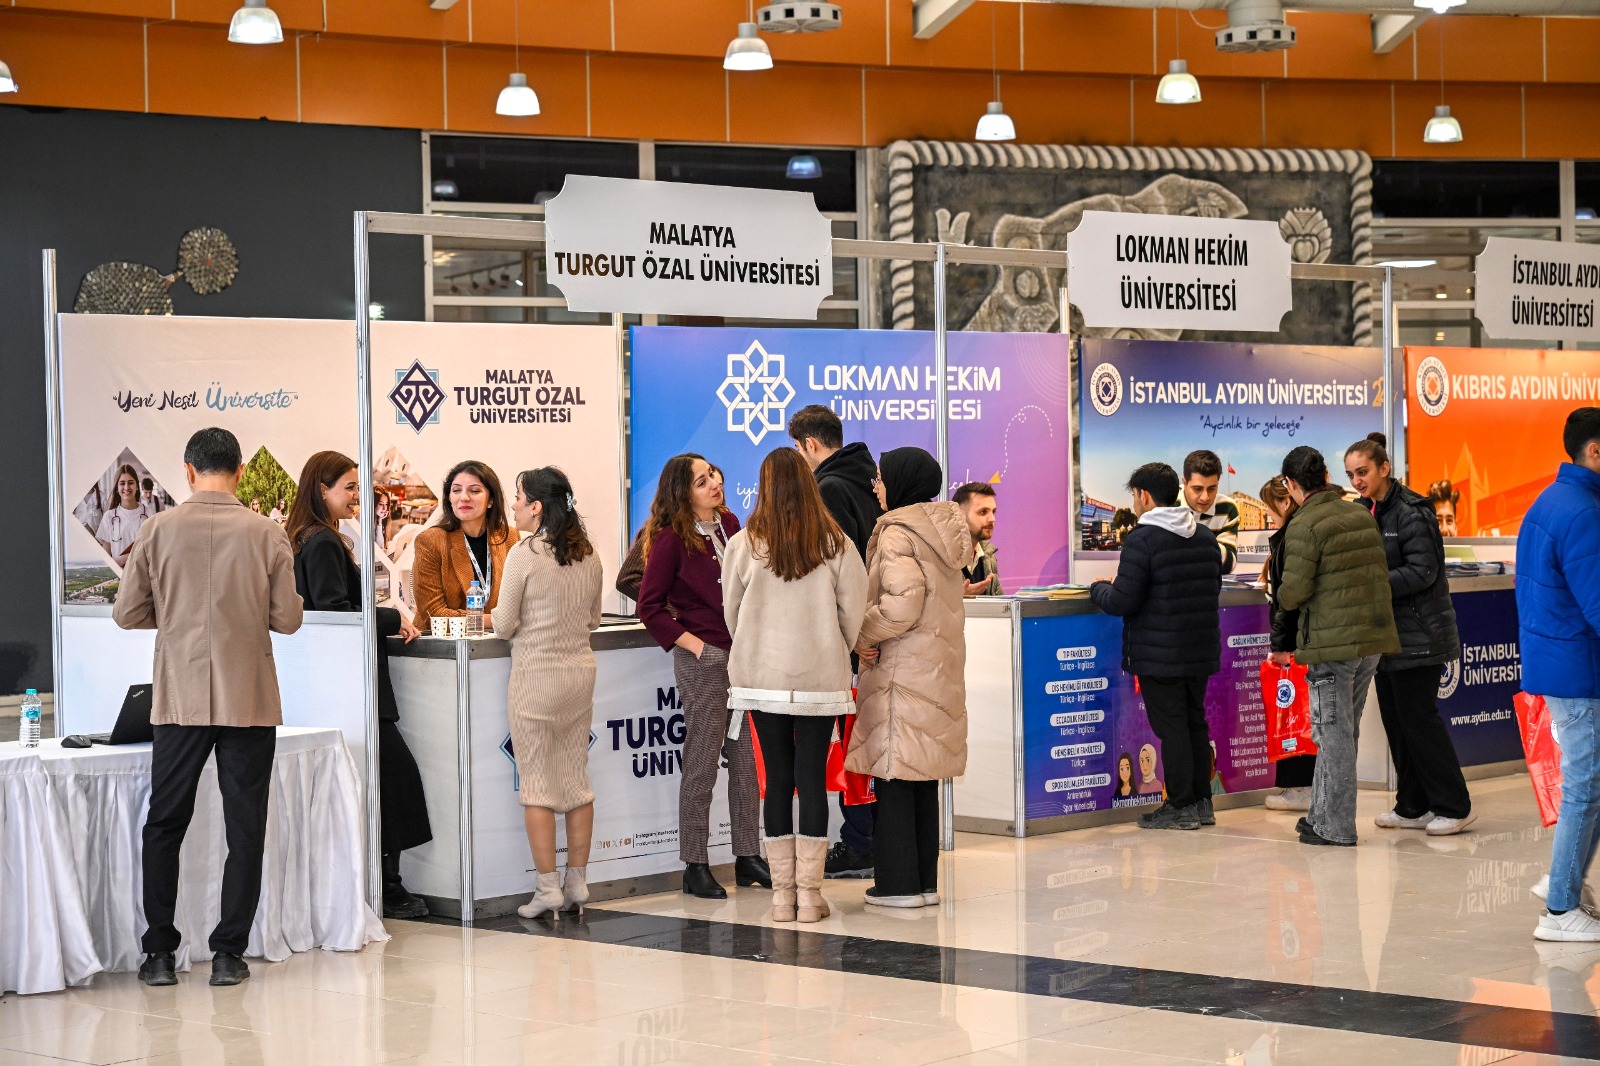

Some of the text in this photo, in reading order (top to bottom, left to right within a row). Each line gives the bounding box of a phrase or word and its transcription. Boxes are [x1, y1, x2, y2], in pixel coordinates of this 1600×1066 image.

[650, 221, 736, 248] MALATYA
[1116, 233, 1248, 266] LOKMAN HEKİM
[554, 250, 820, 286] TURGUT ÖZAL ÜNİVERSİTESİ
[1513, 253, 1573, 287] İSTANBUL
[1120, 275, 1237, 311] ÜNİVERSİTESİ
[1512, 295, 1594, 328] ÜNİVERSİTESİ
[485, 369, 554, 384] MALATYA
[808, 364, 918, 391] LOKMAN
[1452, 374, 1507, 400] KIBRIS
[1509, 375, 1558, 400] AYDIN
[157, 390, 200, 411] Nesil
[454, 386, 586, 406] TURGUT ÖZAL
[1129, 376, 1212, 404] İSTANBUL
[1214, 382, 1263, 405] AYDIN
[1267, 378, 1368, 406] ÜNİVERSİTESİ
[470, 408, 571, 424] ÜNİVERSİTESİ
[831, 395, 981, 421] ÜNİVERSİESİ
[1246, 416, 1261, 430] bir
[1463, 643, 1520, 664] İSTANBUL
[1450, 708, 1512, 726] www.aydin.edu.tr
[606, 713, 687, 751] TURG
